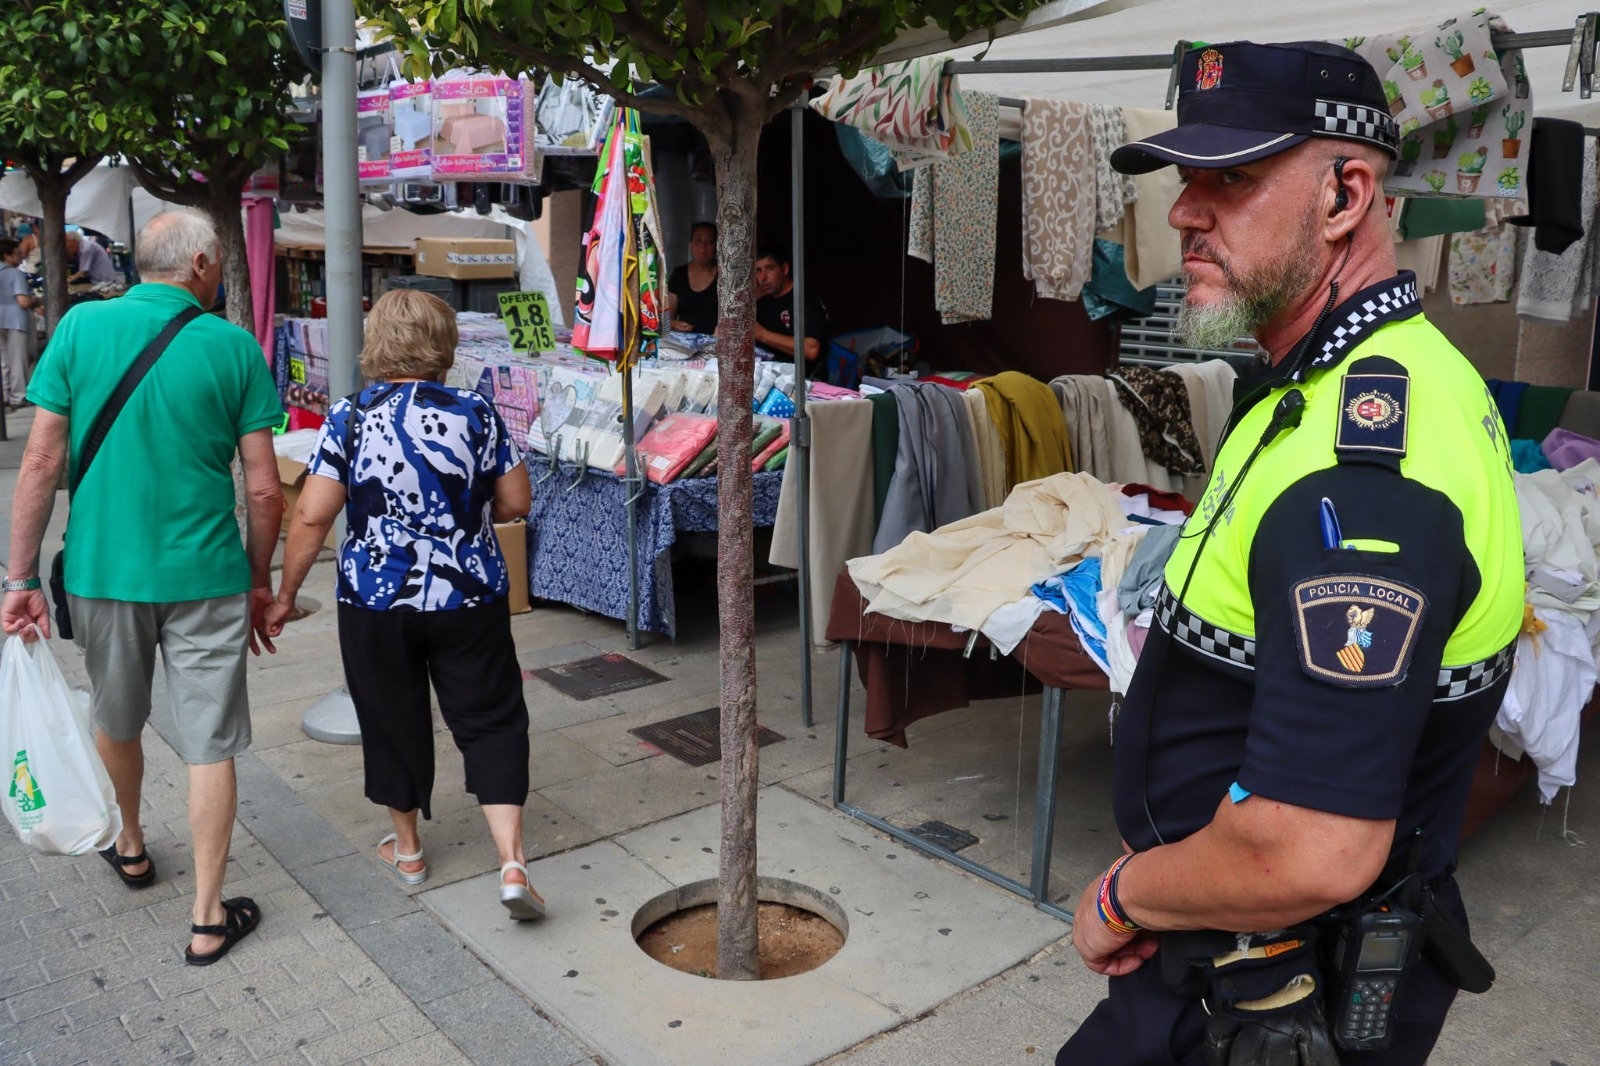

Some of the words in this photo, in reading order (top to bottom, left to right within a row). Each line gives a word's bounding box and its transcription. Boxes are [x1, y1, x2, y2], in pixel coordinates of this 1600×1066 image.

[499, 293, 546, 304] OFERTA
[1309, 583, 1360, 598] POLICIA
[1369, 586, 1410, 609] LOCAL
